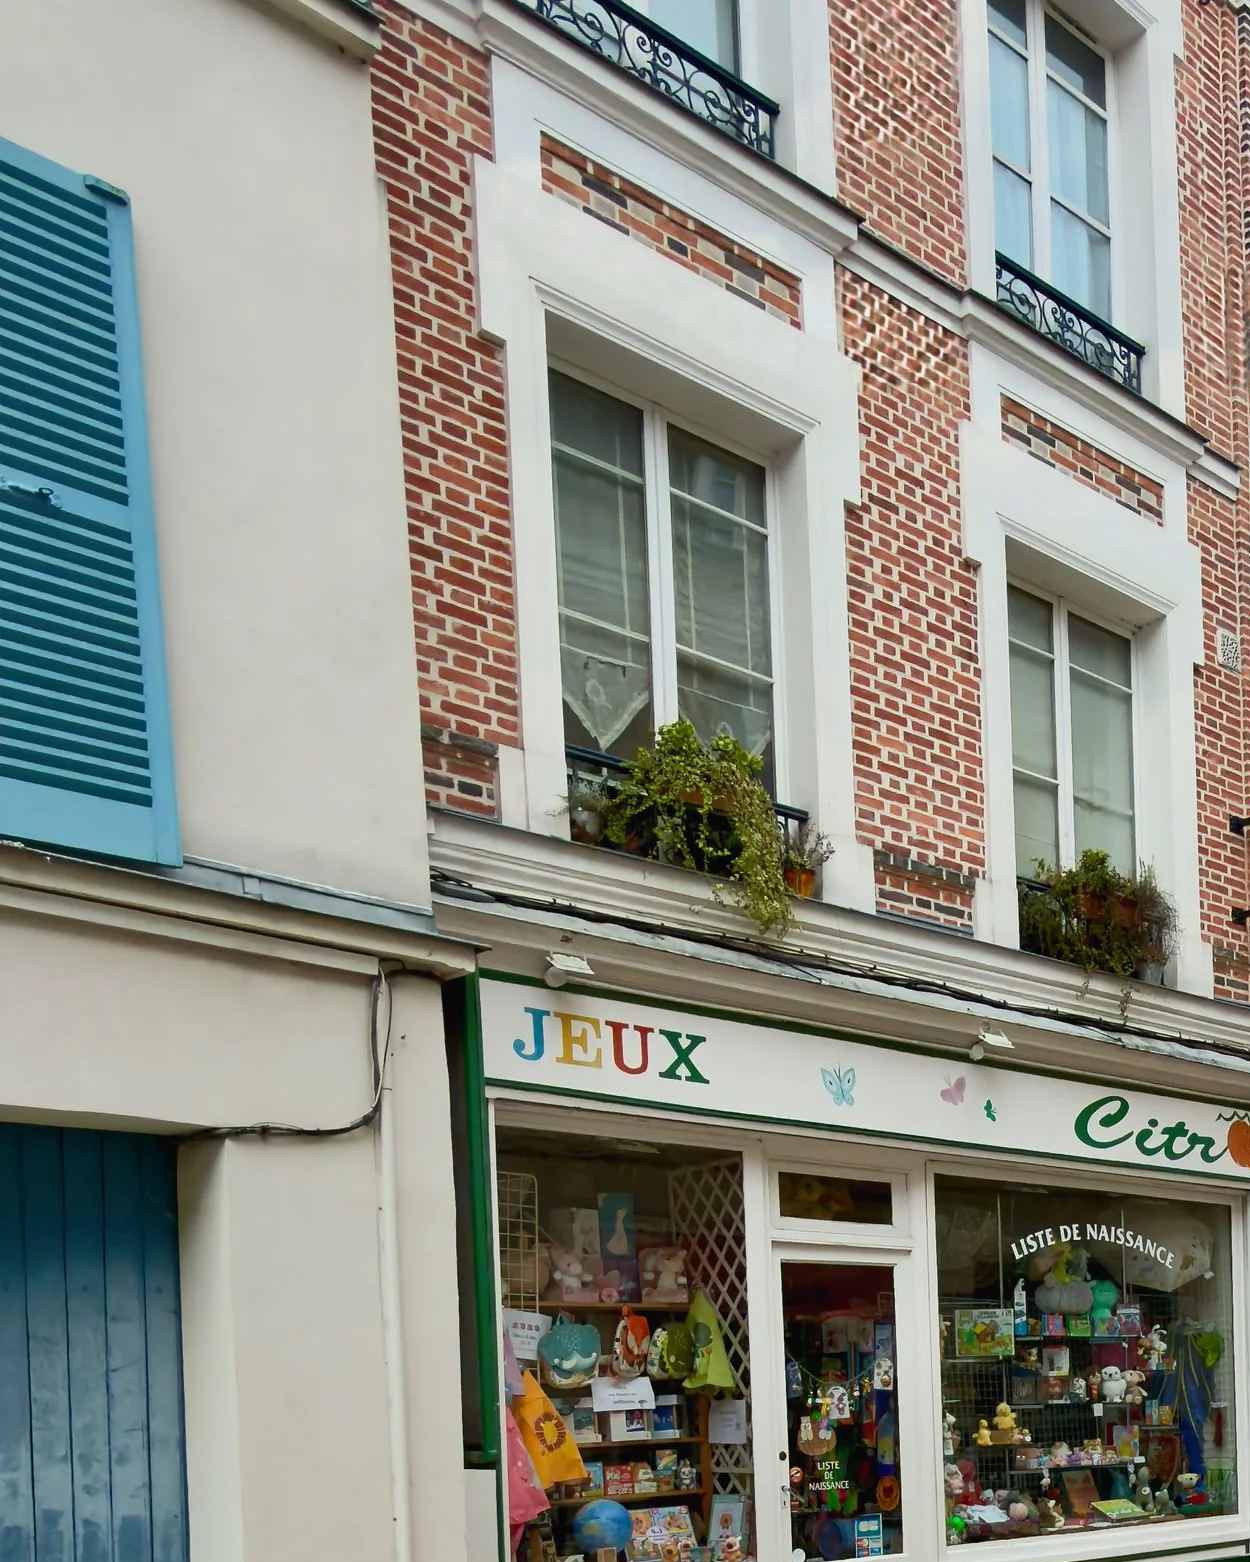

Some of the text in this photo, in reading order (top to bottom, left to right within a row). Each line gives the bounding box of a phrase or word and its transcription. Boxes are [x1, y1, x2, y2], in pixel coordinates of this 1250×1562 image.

[513, 1006, 710, 1085] JEUX
[1011, 1223, 1175, 1269] LISTE DE NAISSANCE
[817, 1460, 840, 1470] LISTE
[824, 1471, 834, 1480] DE
[808, 1480, 850, 1491] NAISSANCE
